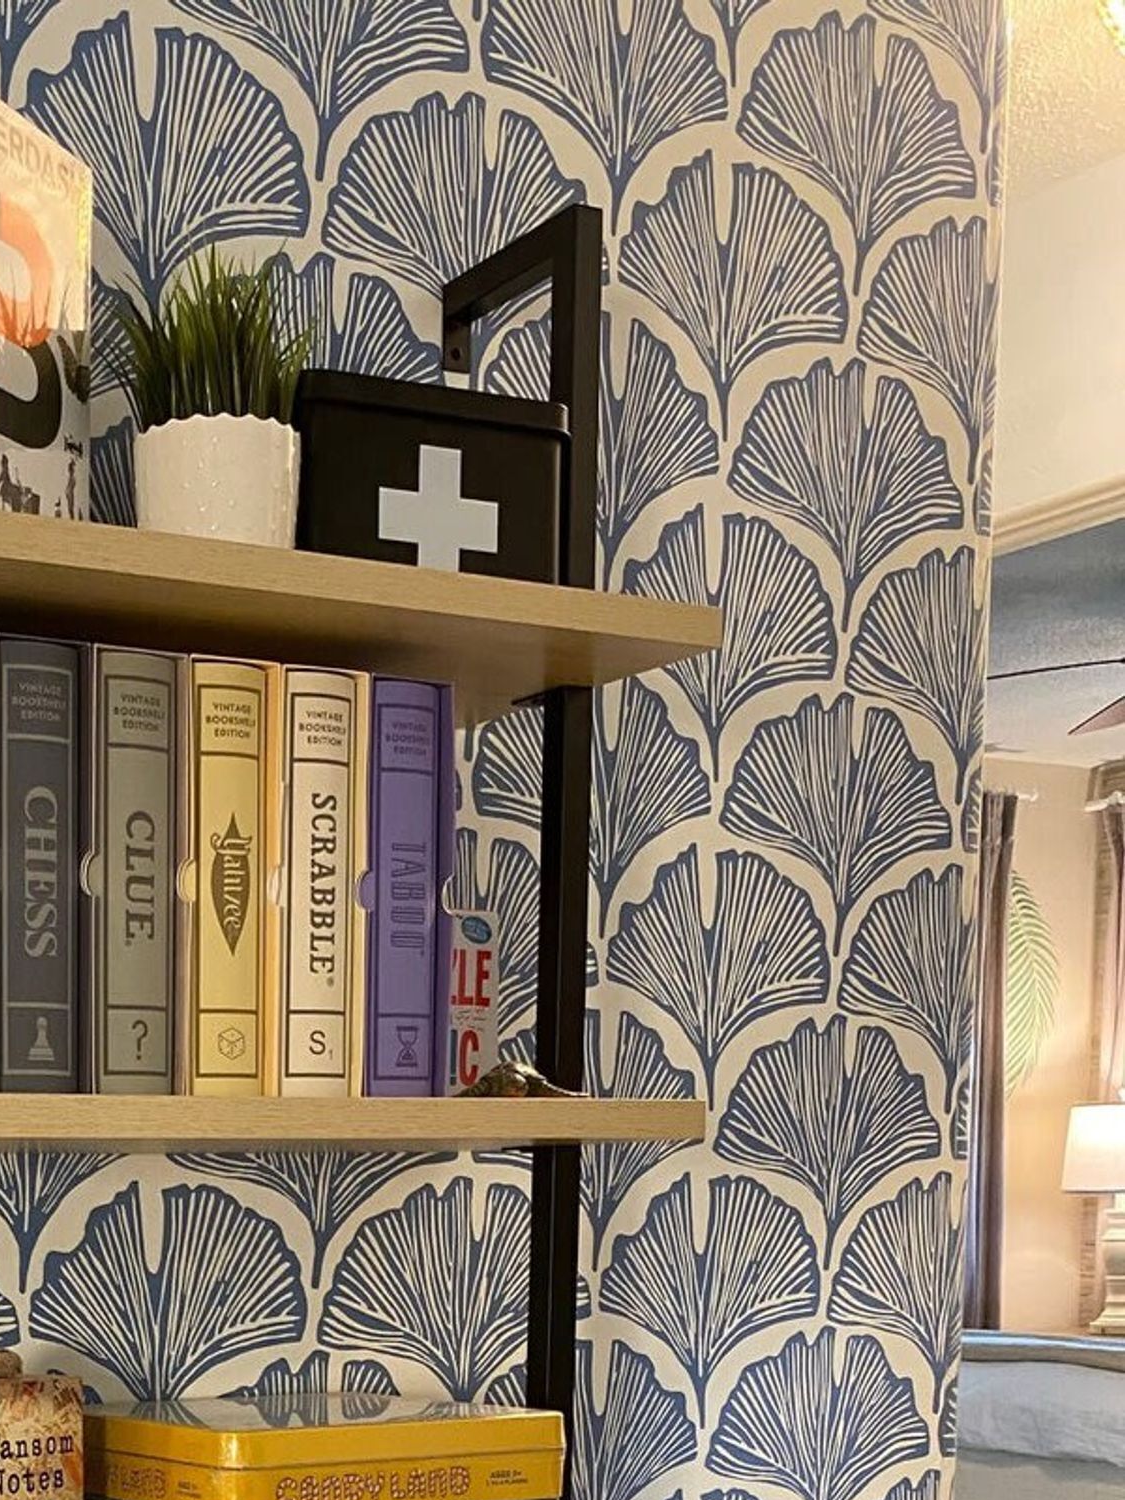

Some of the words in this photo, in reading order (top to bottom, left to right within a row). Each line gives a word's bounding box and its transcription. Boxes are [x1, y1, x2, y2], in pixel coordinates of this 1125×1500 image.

[19, 682, 62, 696] VINTAGE
[120, 694, 161, 707] VINTAGE
[212, 702, 252, 714] VINTAGE
[20, 710, 61, 722] EDITION
[306, 710, 343, 723] VINTAGE
[122, 719, 160, 732] EDITION
[214, 728, 251, 739] EDITION
[307, 736, 342, 747] EDITION
[25, 786, 58, 958] CHESS
[124, 810, 155, 941] CLUE
[210, 832, 252, 929] Yahtzee
[310, 793, 337, 975] SCRABBLE
[391, 842, 426, 949] TABOO
[451, 949, 491, 1007] LE
[490, 1471, 510, 1479] AGES
[389, 1465, 471, 1500] LAND
